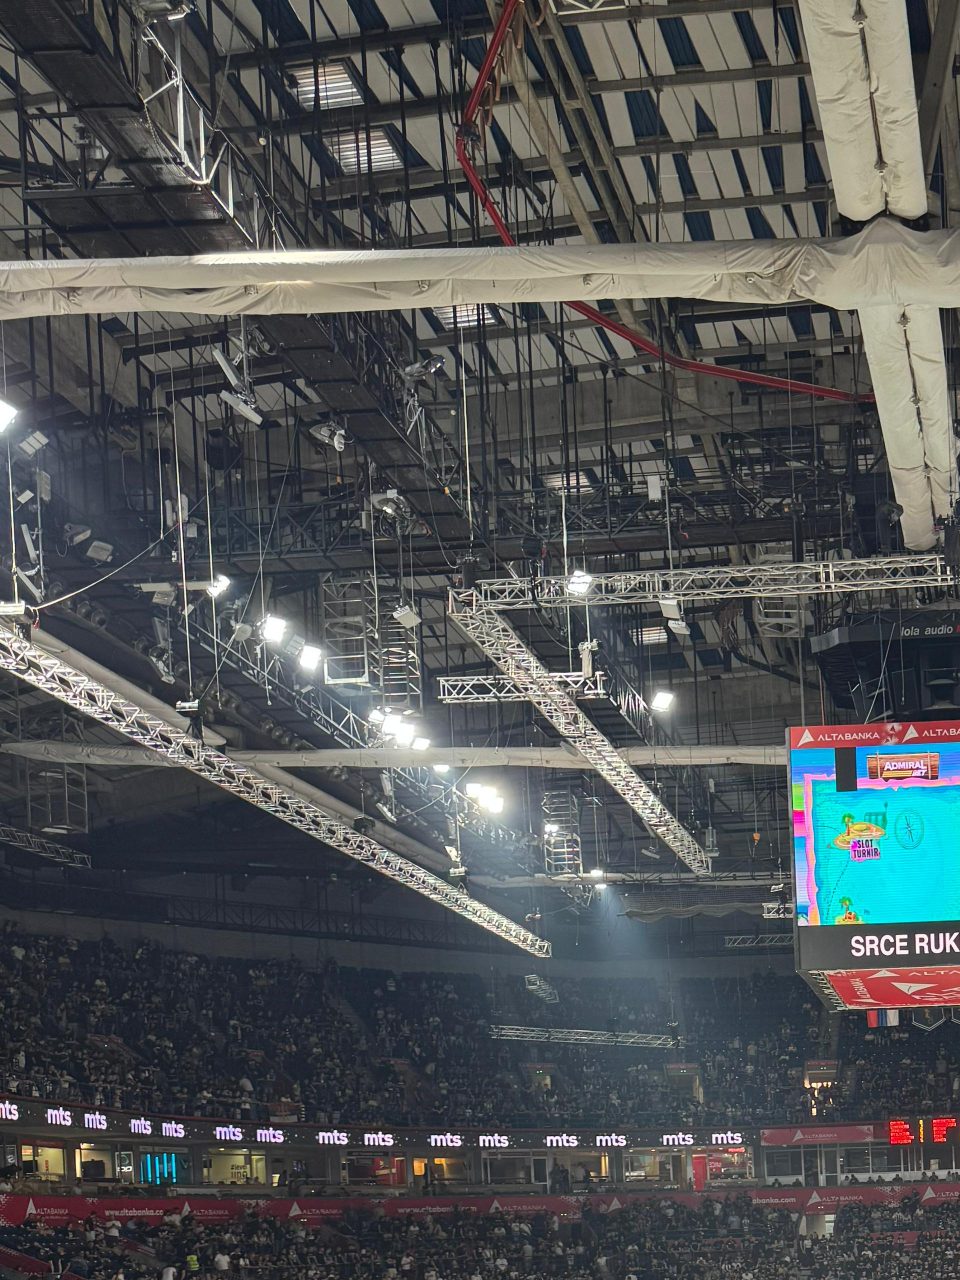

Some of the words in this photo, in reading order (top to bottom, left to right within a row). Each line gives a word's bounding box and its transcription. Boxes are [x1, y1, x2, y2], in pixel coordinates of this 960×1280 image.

[901, 626, 920, 637] lola
[924, 624, 954, 636] audio
[817, 730, 880, 742] ALTABANKA
[884, 760, 927, 771] ADMIRAL
[857, 839, 873, 849] SLOT
[853, 847, 879, 859] TURNIR
[851, 934, 908, 958] SRCE
[47, 1106, 73, 1127] mts
[84, 1111, 108, 1130] mts
[130, 1116, 152, 1135] mts
[161, 1120, 186, 1138] mts
[212, 1124, 243, 1142] mts
[256, 1126, 285, 1144] mts
[315, 1129, 350, 1146] mts
[363, 1131, 395, 1147] mts
[430, 1132, 463, 1147] mts
[478, 1132, 510, 1148] mts
[546, 1132, 580, 1147] mts
[595, 1132, 627, 1147] mts
[662, 1131, 695, 1146] mts
[711, 1130, 743, 1145] mts
